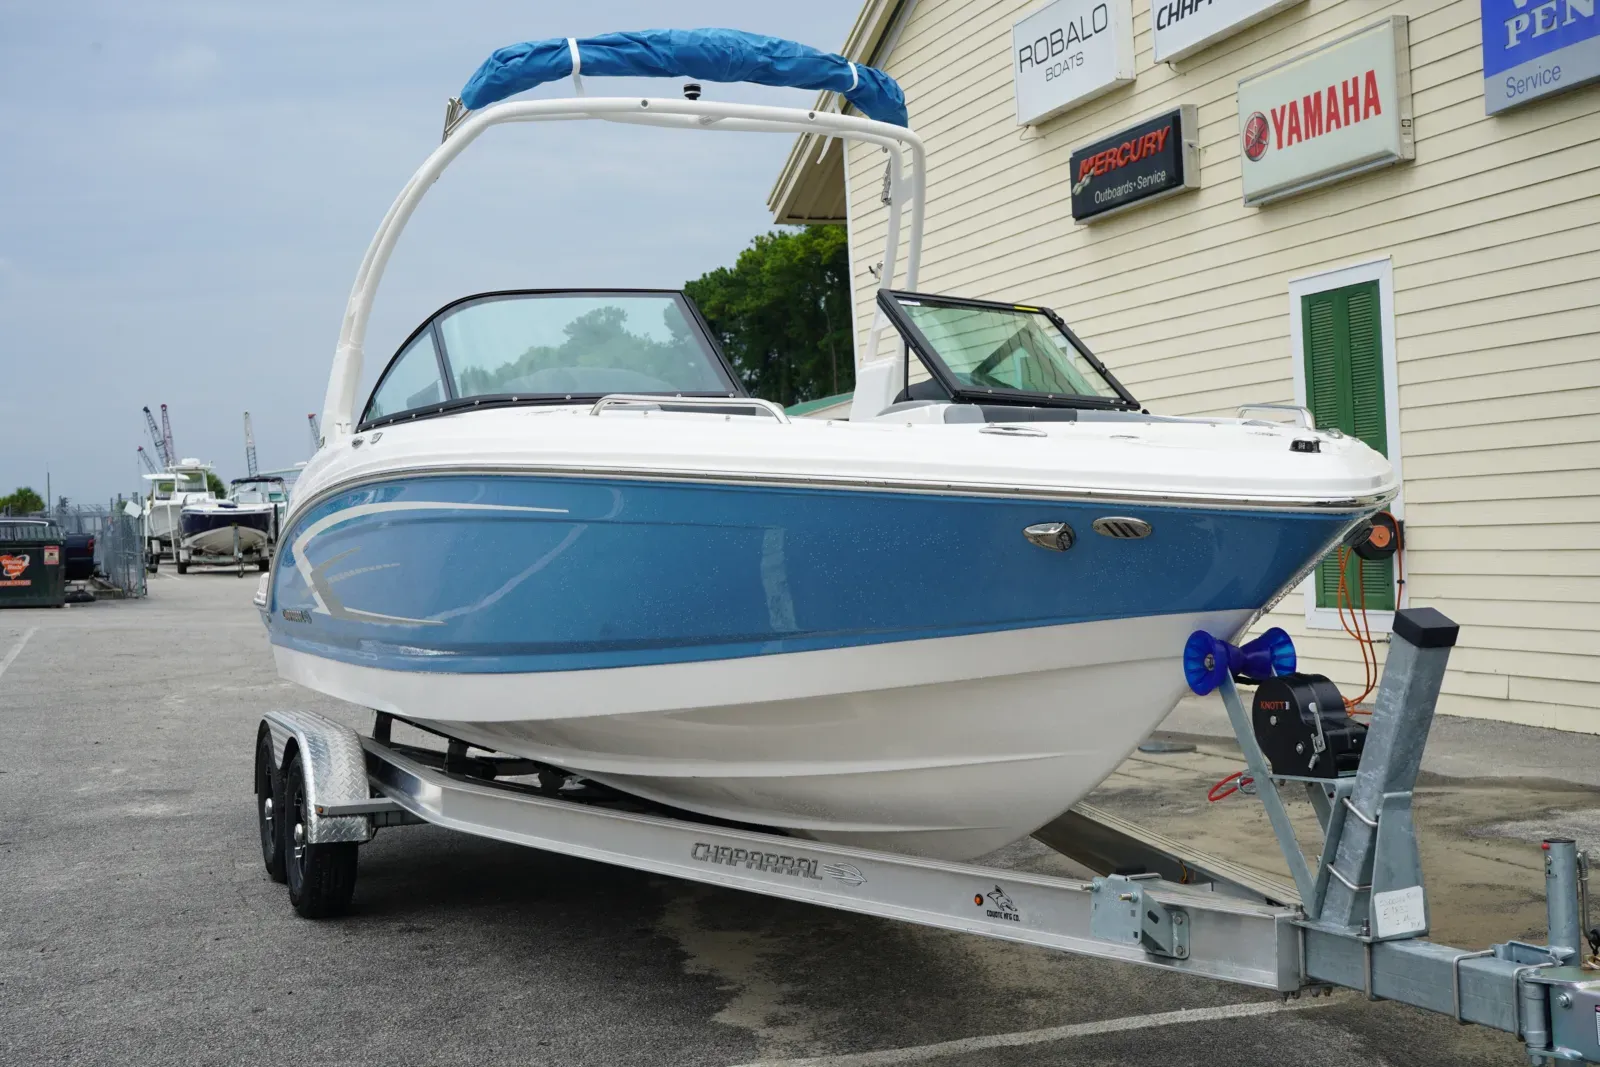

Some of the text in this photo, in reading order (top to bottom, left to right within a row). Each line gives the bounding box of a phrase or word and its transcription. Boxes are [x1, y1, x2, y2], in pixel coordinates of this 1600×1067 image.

[1156, 0, 1212, 31] CHAP
[1018, 3, 1108, 73] ROBALO
[1045, 51, 1084, 82] BOATS
[1506, 65, 1562, 98] Service
[1270, 69, 1382, 150] YAMAHA
[1078, 125, 1171, 182] MERCURY
[1260, 701, 1285, 710] KNOTT
[690, 842, 823, 881] CHAPARRAL
